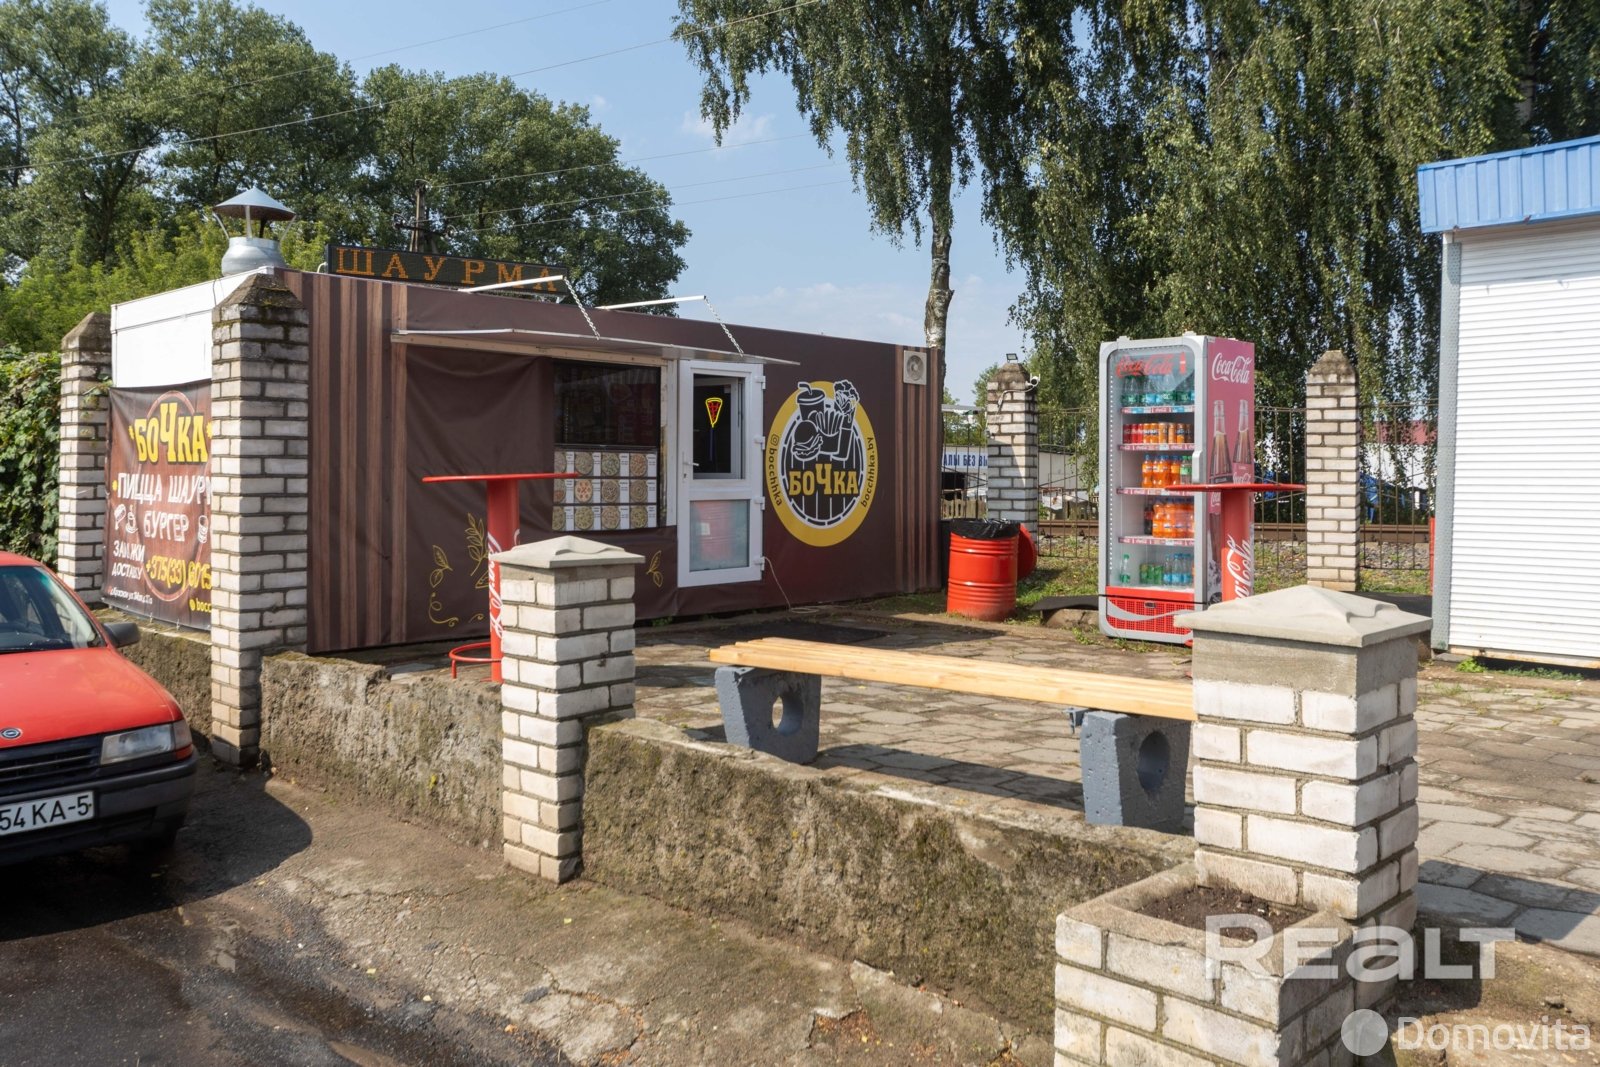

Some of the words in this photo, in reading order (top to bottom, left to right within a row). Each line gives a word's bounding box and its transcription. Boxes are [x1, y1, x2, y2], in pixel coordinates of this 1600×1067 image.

[335, 247, 557, 292] ШАУРМА
[1211, 352, 1252, 384] Coca-Cola
[134, 402, 208, 463] БОЧКА
[861, 437, 876, 508] bocchhka.by
[963, 454, 976, 466] БЕЗ
[117, 472, 162, 505] ПИЦЦА
[768, 447, 783, 507] bocchhka
[789, 463, 859, 496] БОЧКА
[143, 510, 190, 542] БУРГЕР
[146, 555, 186, 591] +375(33)
[32, 795, 90, 826] KA-5
